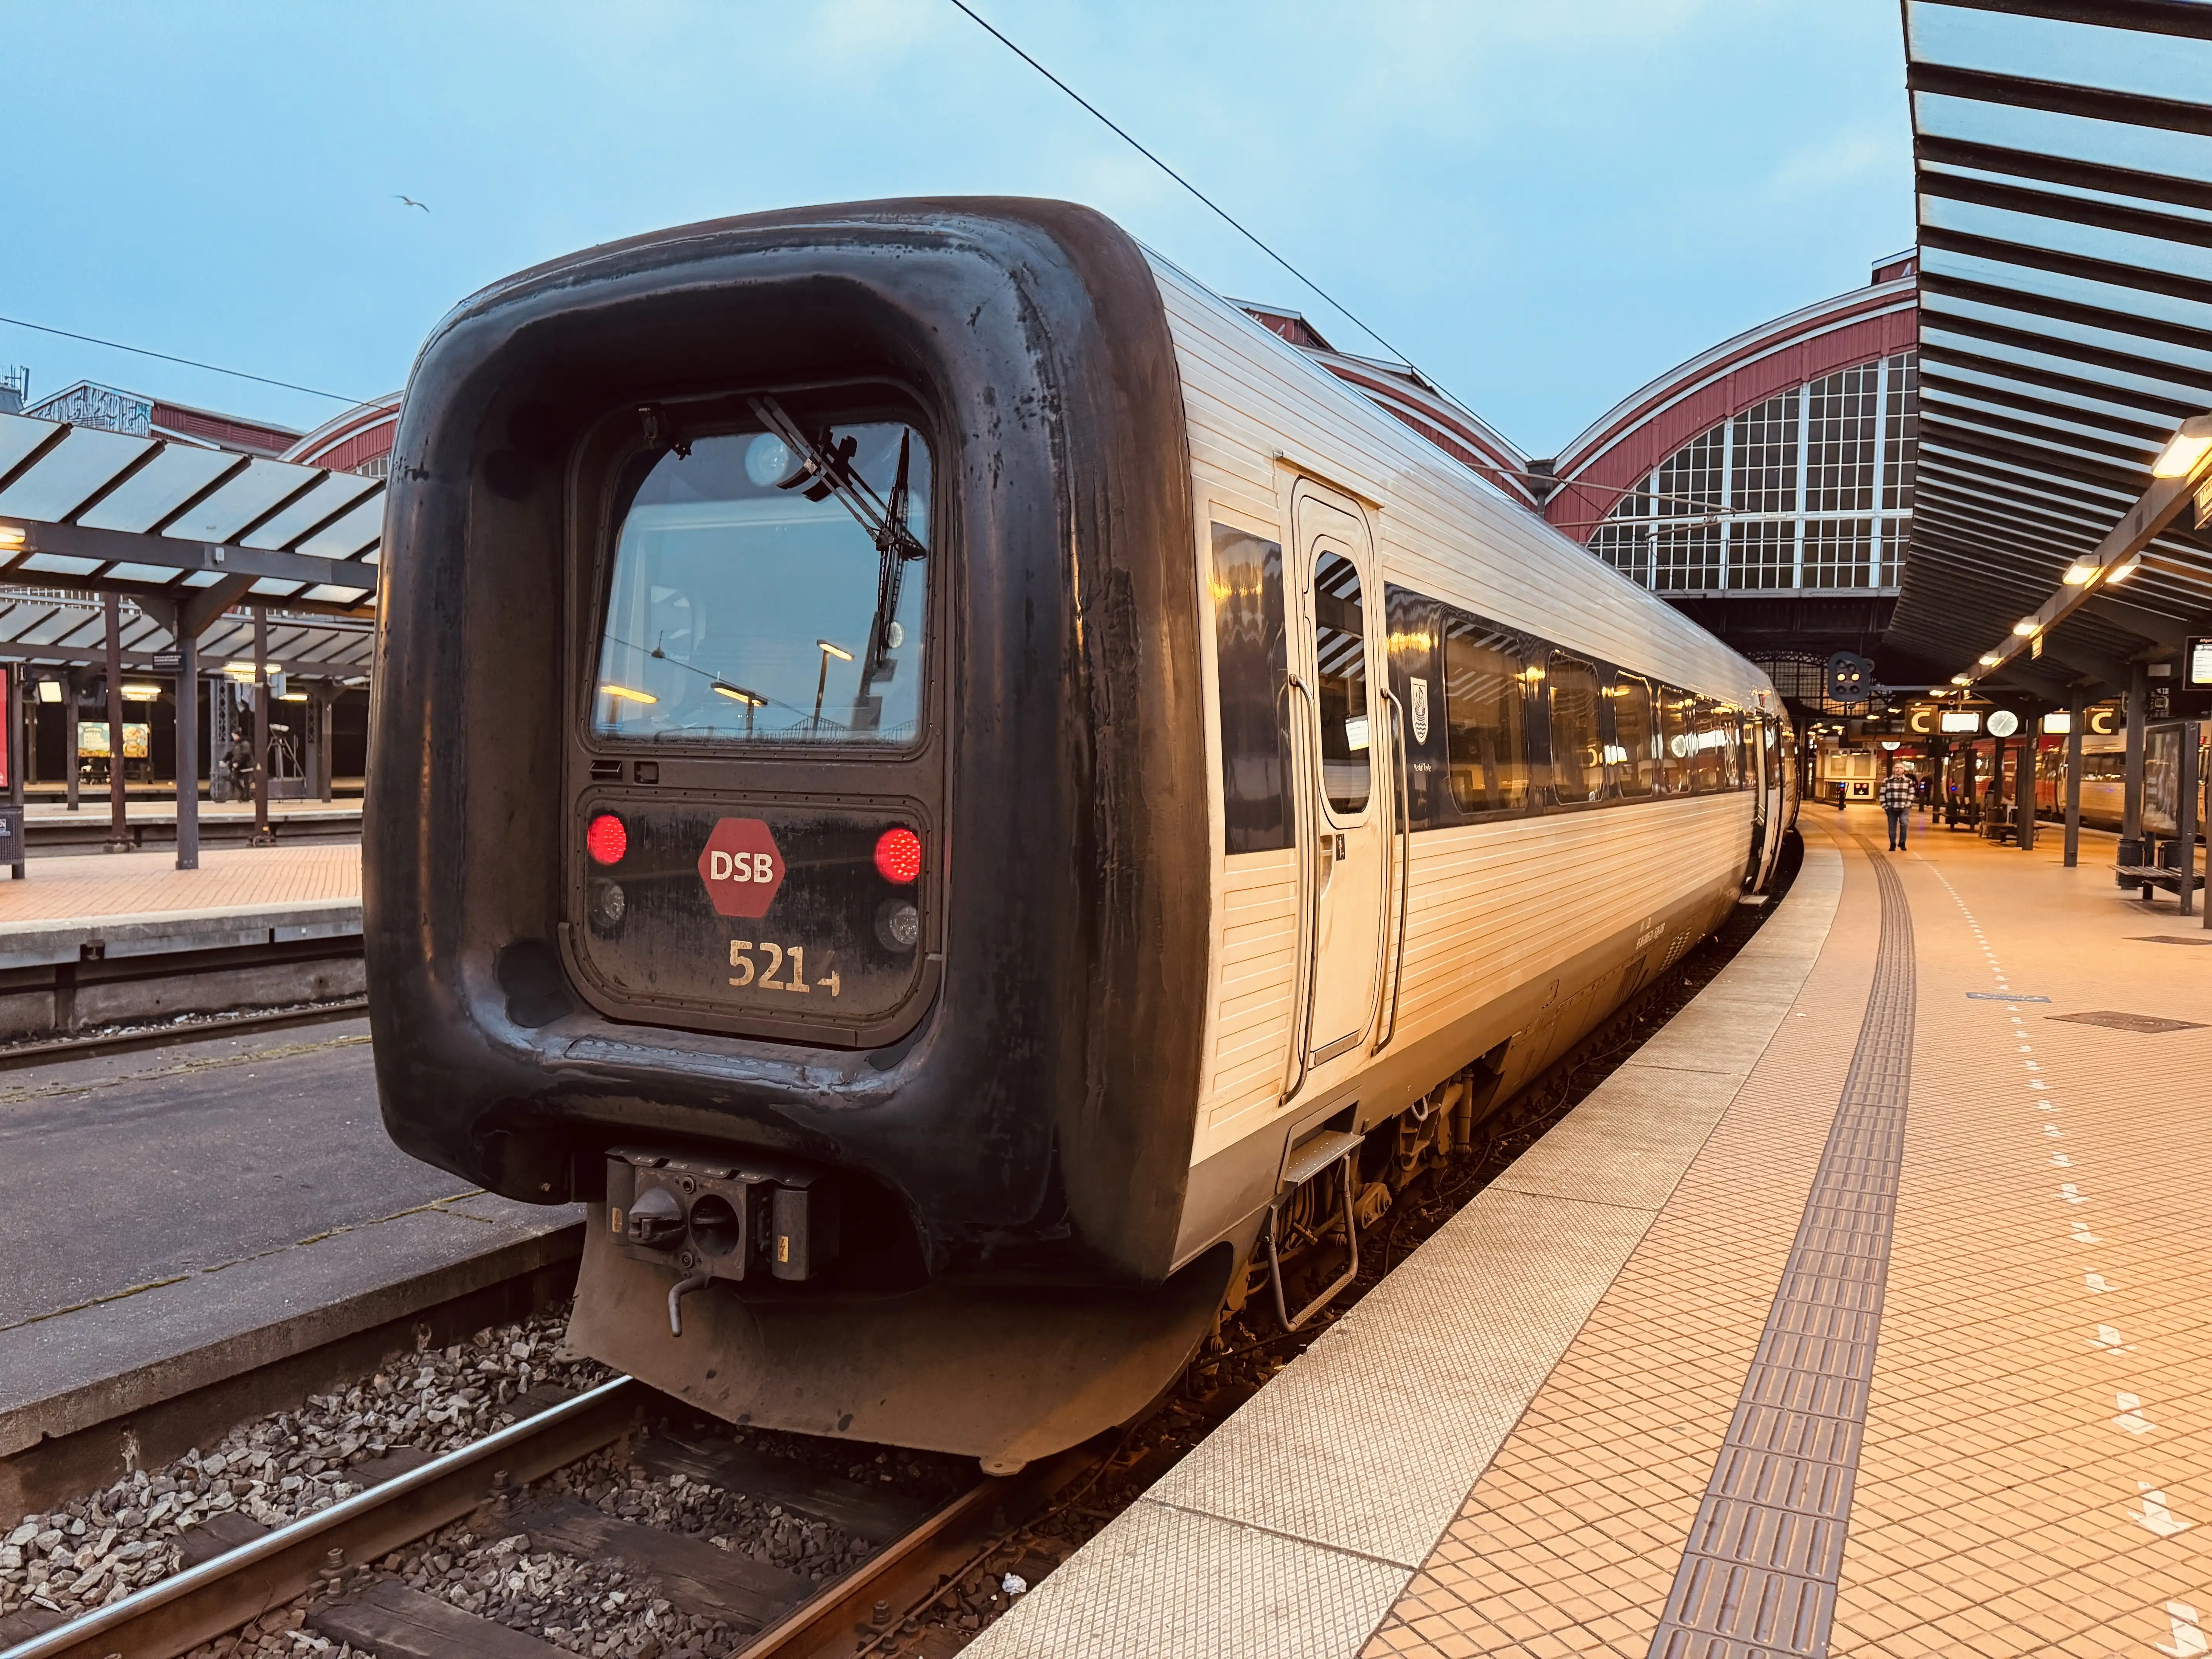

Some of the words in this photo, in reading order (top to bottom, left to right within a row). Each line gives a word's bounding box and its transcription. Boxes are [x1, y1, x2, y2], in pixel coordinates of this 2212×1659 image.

[1911, 711, 1930, 733] C
[2092, 712, 2112, 734] C
[711, 851, 773, 883] DSB
